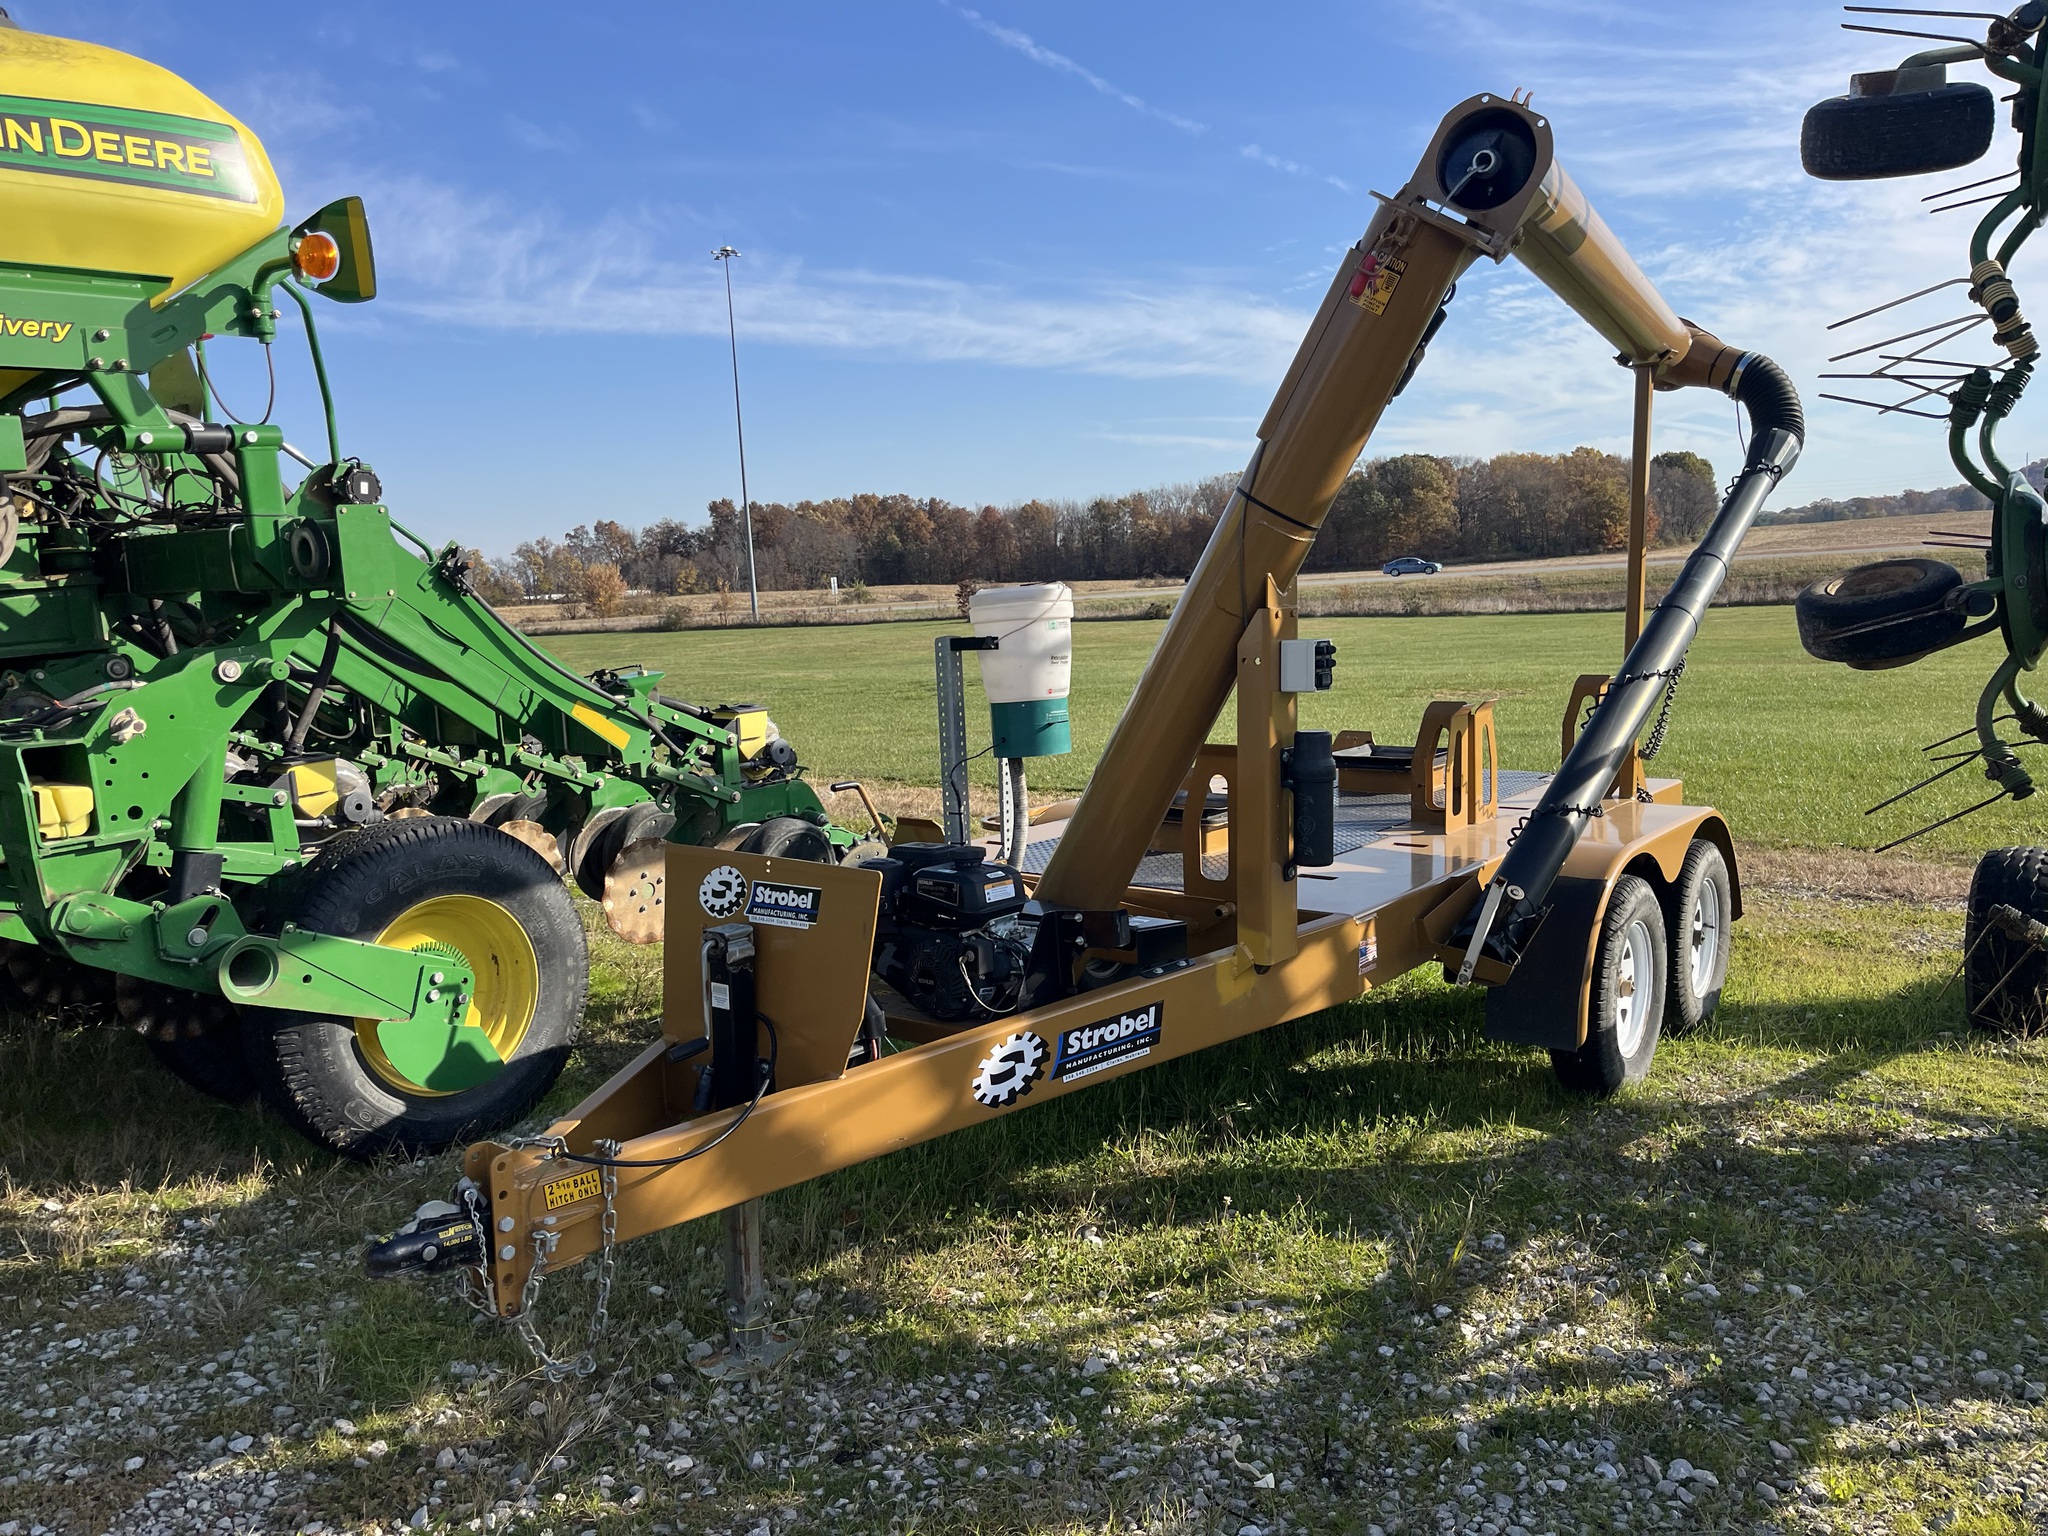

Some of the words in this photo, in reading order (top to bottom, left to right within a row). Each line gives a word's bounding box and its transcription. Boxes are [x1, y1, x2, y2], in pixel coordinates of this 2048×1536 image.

[50, 118, 214, 176] DEERE
[1377, 252, 1408, 273] CATION
[364, 853, 513, 905] GALAXY
[755, 886, 813, 909] Strobel
[797, 913, 809, 921] INC.
[1067, 1006, 1155, 1055] Strobel
[1065, 1043, 1134, 1070] MANUFACTURING,
[1136, 1036, 1153, 1046] INC.
[1125, 1049, 1148, 1060] Nebraska
[548, 1185, 554, 1195] 2
[573, 1174, 596, 1188] BALL
[549, 1192, 575, 1208] HITCH
[578, 1184, 598, 1199] ONLY
[460, 1235, 473, 1243] LBS
